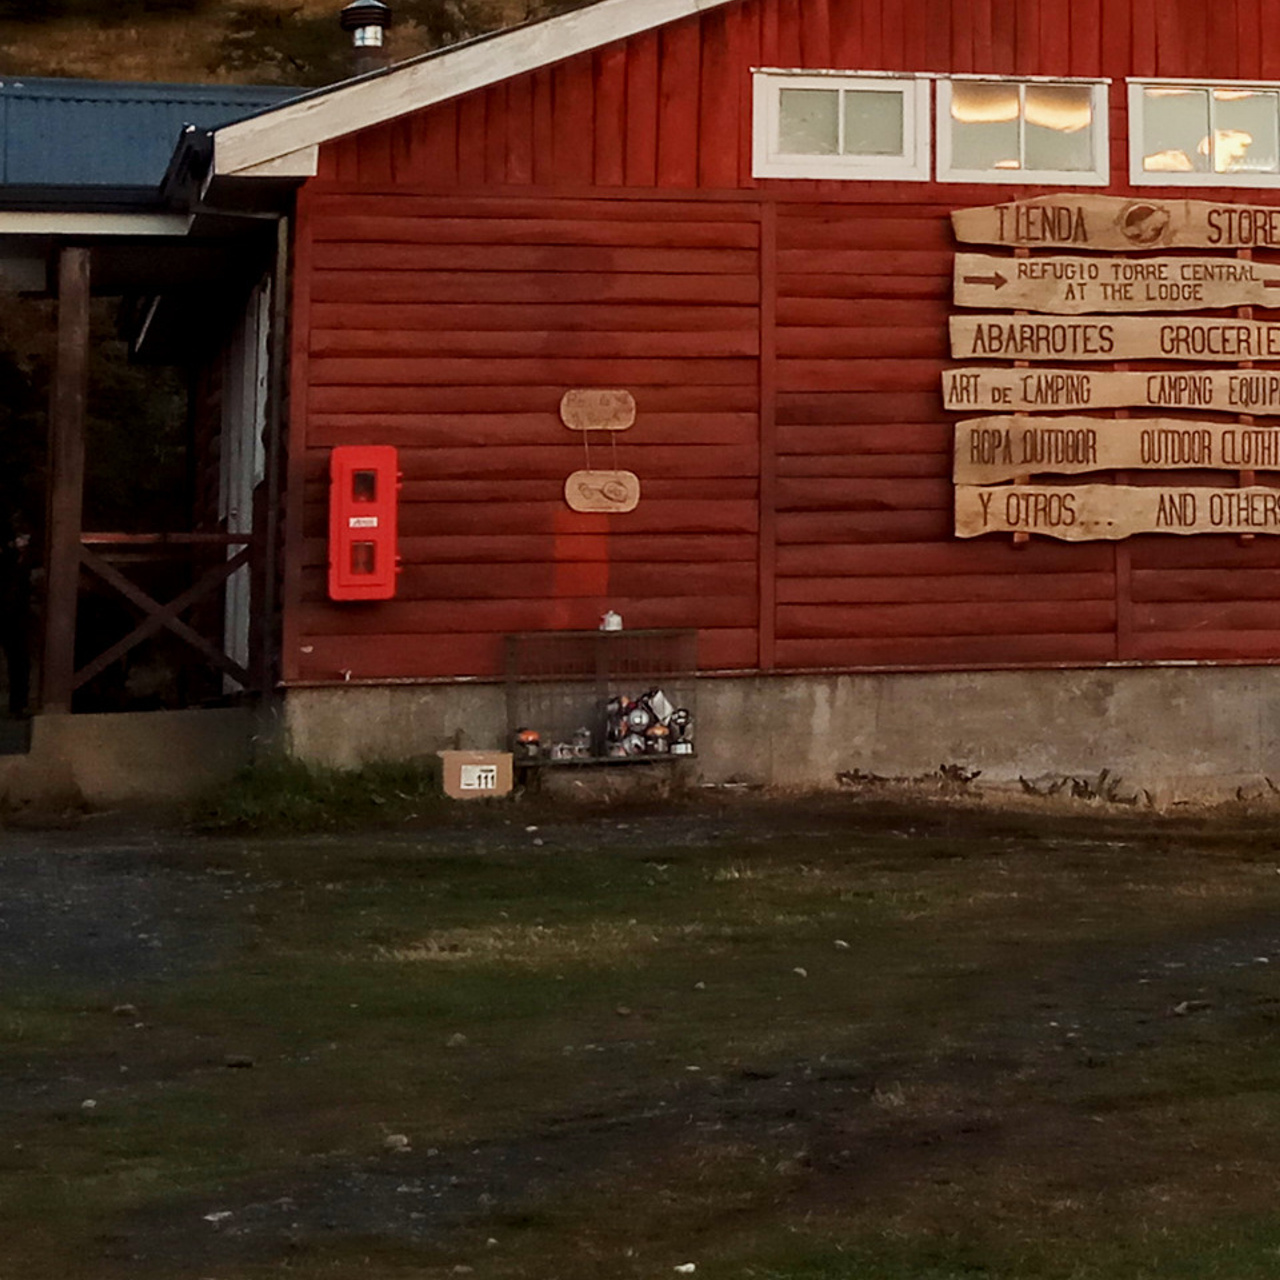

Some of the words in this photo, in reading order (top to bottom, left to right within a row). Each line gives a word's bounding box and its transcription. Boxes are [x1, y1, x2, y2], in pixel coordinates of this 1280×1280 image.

[994, 206, 1088, 242] TIENDA
[1017, 262, 1099, 280] REFUGIO
[1111, 263, 1168, 281] TORRE
[1180, 264, 1260, 282] CENTRAL
[1065, 283, 1087, 300] AT
[1100, 283, 1133, 300] THE
[1146, 283, 1203, 301] LODGE
[972, 323, 1114, 354] ABARROTES
[949, 374, 980, 404] ART
[991, 387, 1012, 404] DE
[1020, 374, 1091, 404] CAMPING
[1147, 375, 1213, 405] CAMPING
[970, 428, 1013, 465] ROPA
[1020, 428, 1097, 465] OUTDOOR
[1140, 429, 1212, 465] OUTDOOR
[978, 492, 992, 527] Y
[1156, 492, 1197, 528] AND
